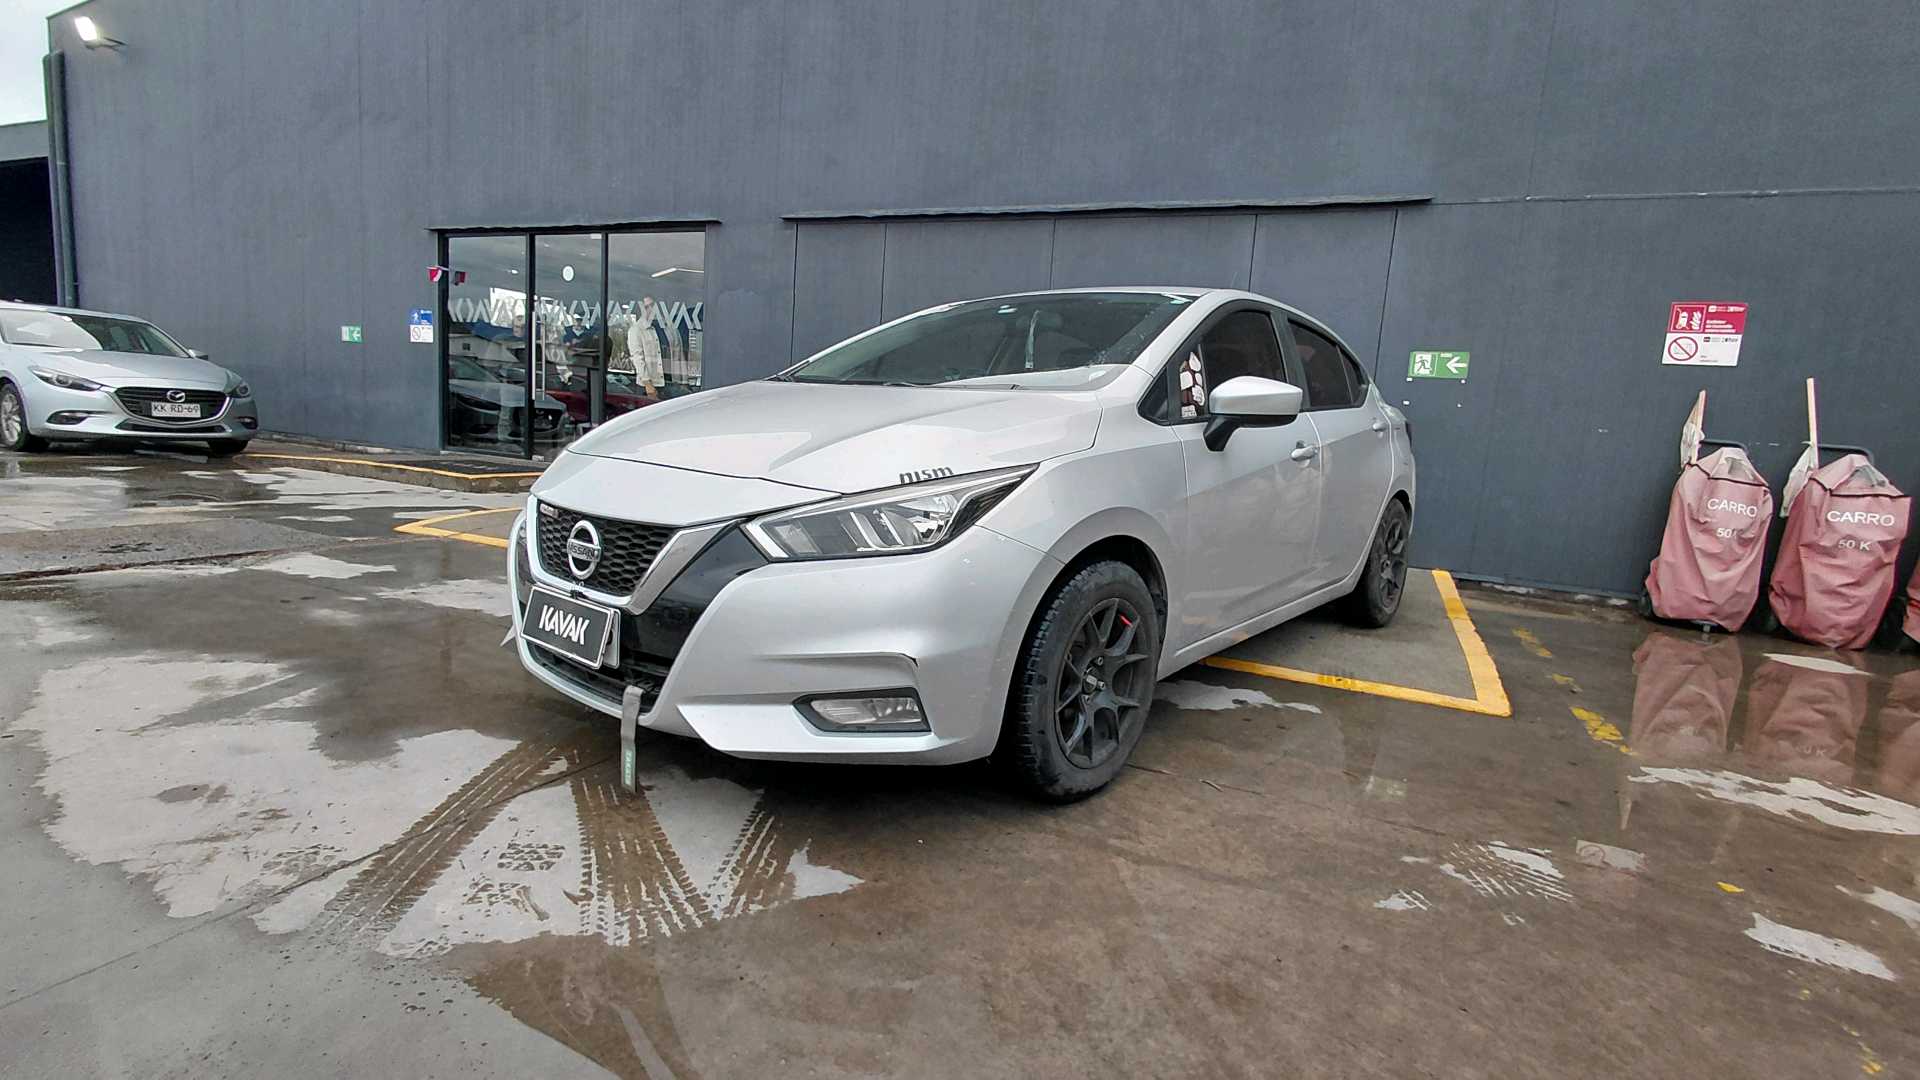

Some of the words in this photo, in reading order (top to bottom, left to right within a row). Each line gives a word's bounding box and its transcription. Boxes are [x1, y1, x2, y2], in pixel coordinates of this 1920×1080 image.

[1707, 498, 1758, 518] CARRO
[1827, 510, 1895, 527] CARRO
[1716, 527, 1732, 538] 50
[1838, 539, 1856, 549] 50
[538, 604, 590, 646] KAVAK
